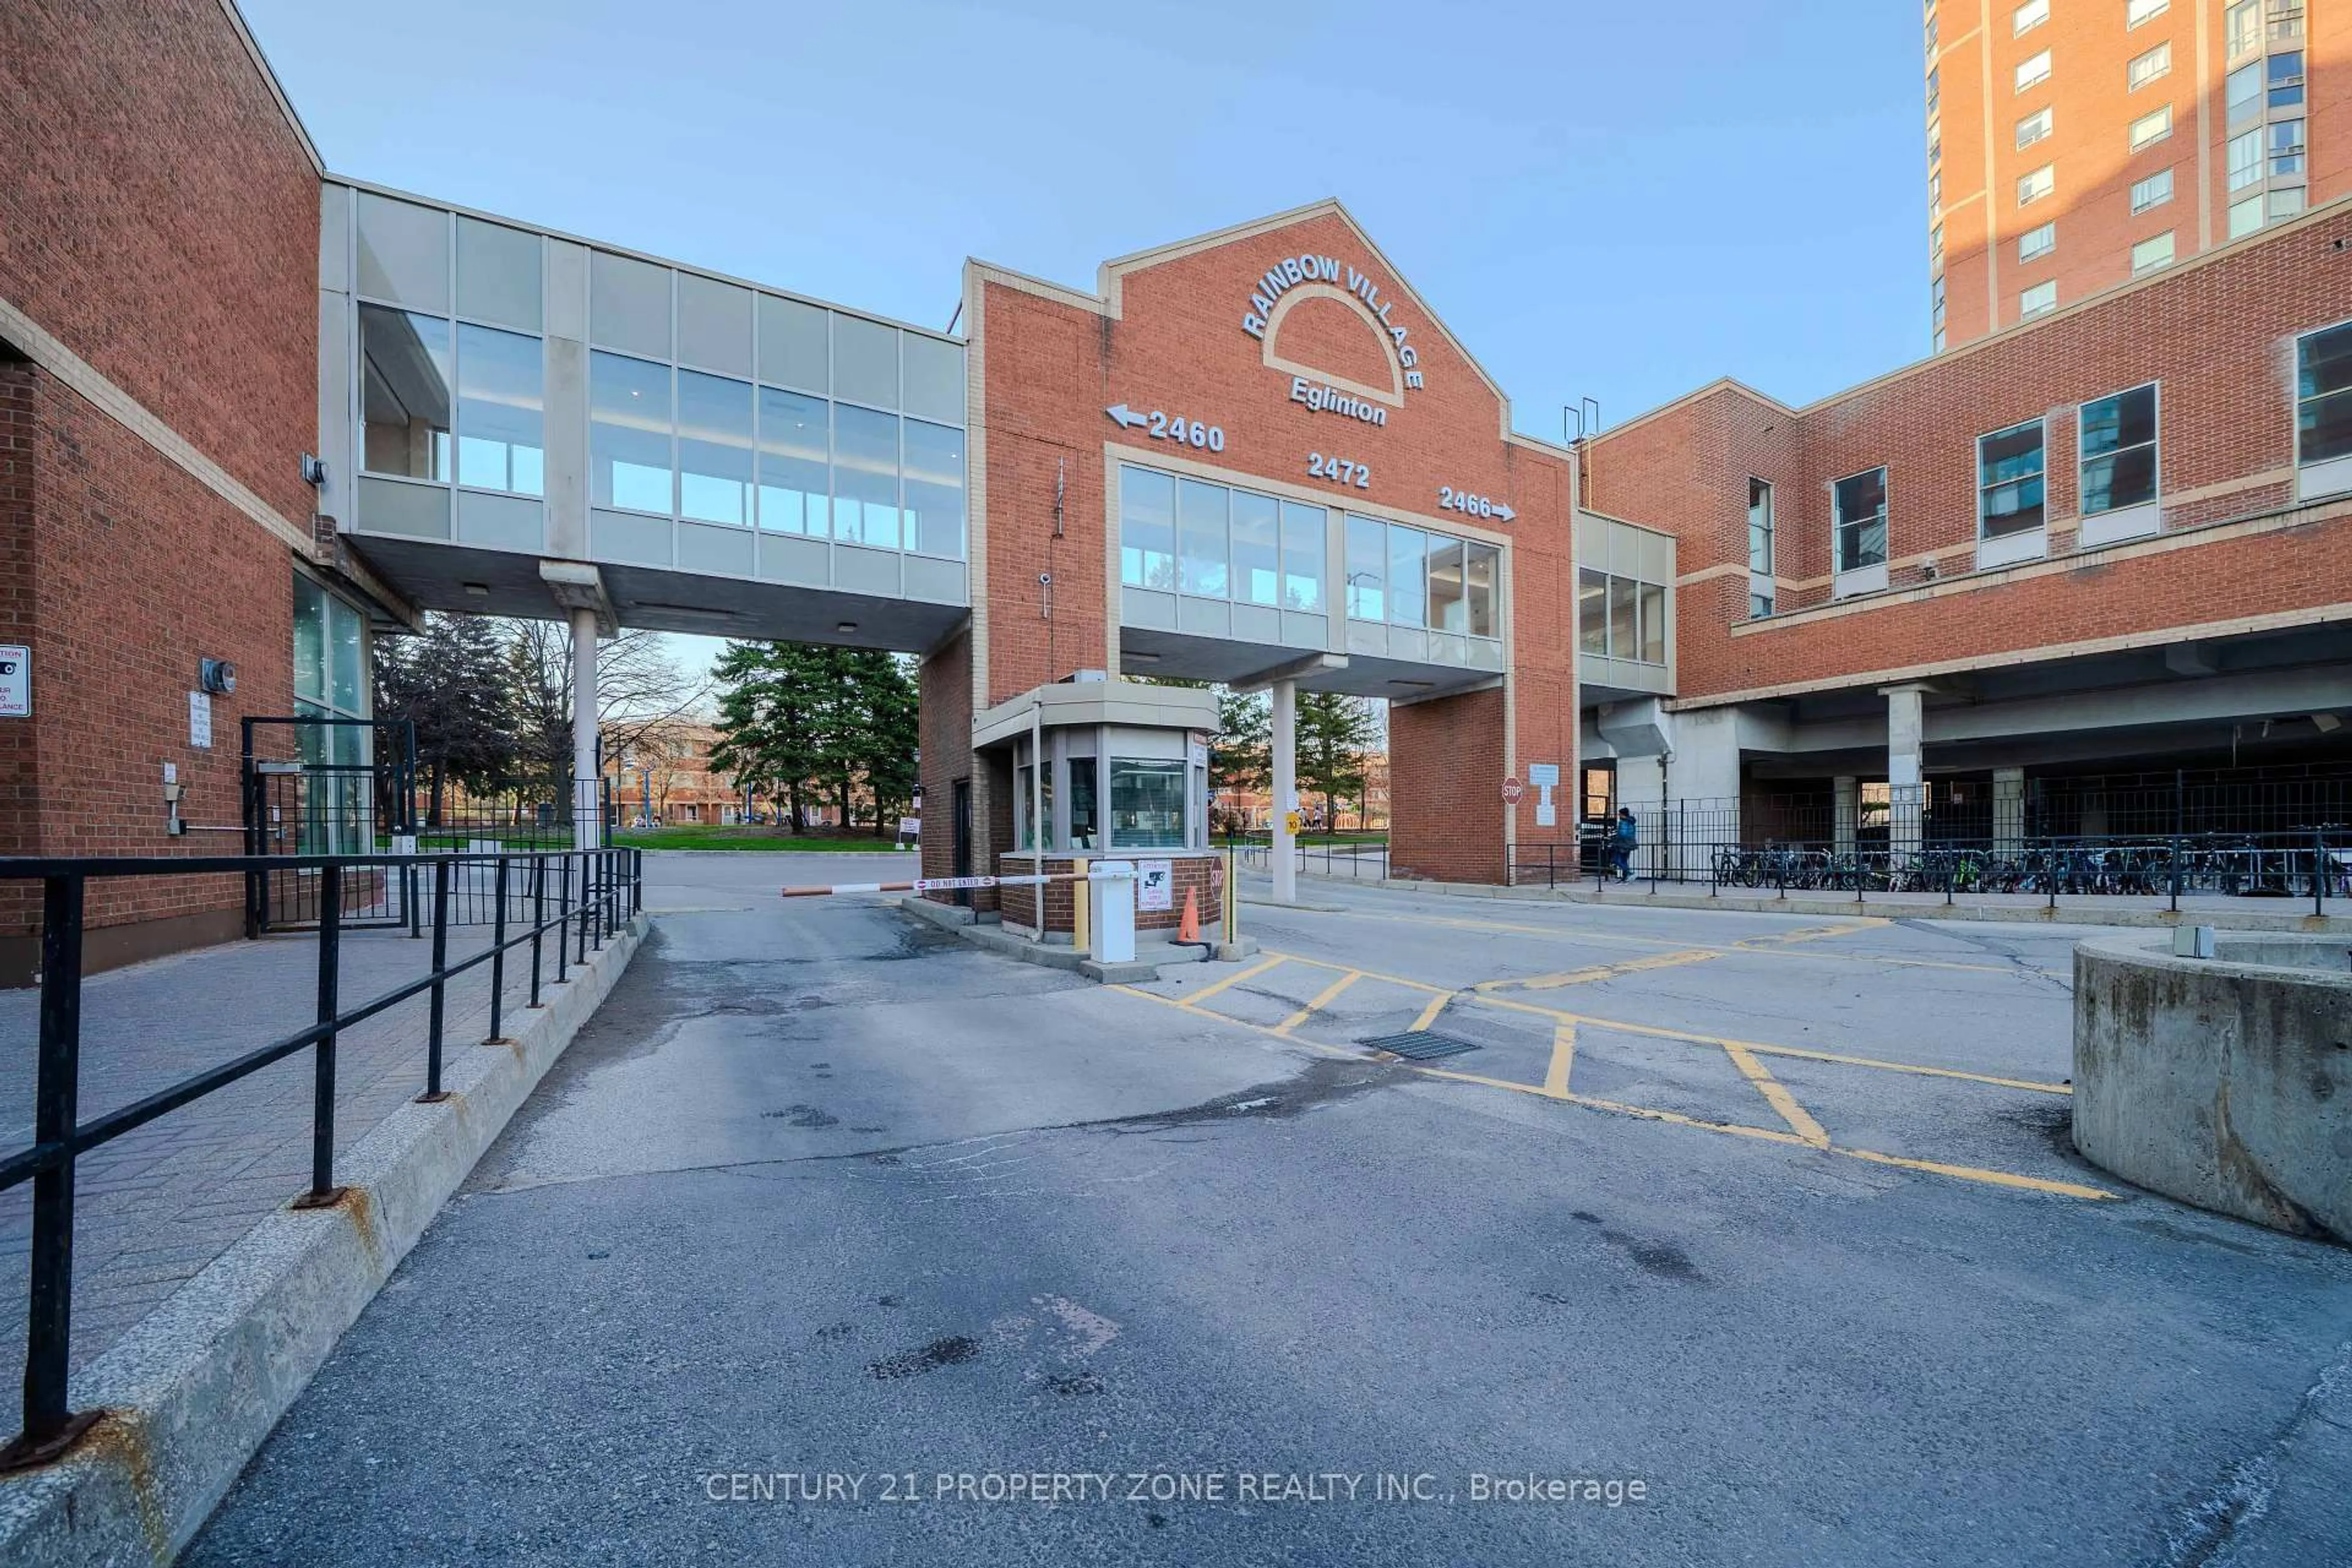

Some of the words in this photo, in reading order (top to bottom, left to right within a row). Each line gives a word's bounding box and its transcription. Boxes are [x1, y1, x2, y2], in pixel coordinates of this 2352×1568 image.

[1243, 254, 1340, 341] RAINBOW
[1348, 266, 1423, 390] VILLAGE
[1290, 376, 1387, 426] Eglinton
[1149, 410, 1225, 453] 2460
[1307, 451, 1370, 489] 2472
[1439, 486, 1491, 518] 2466
[1504, 786, 1521, 796] STOP
[1212, 870, 1223, 887] STOP
